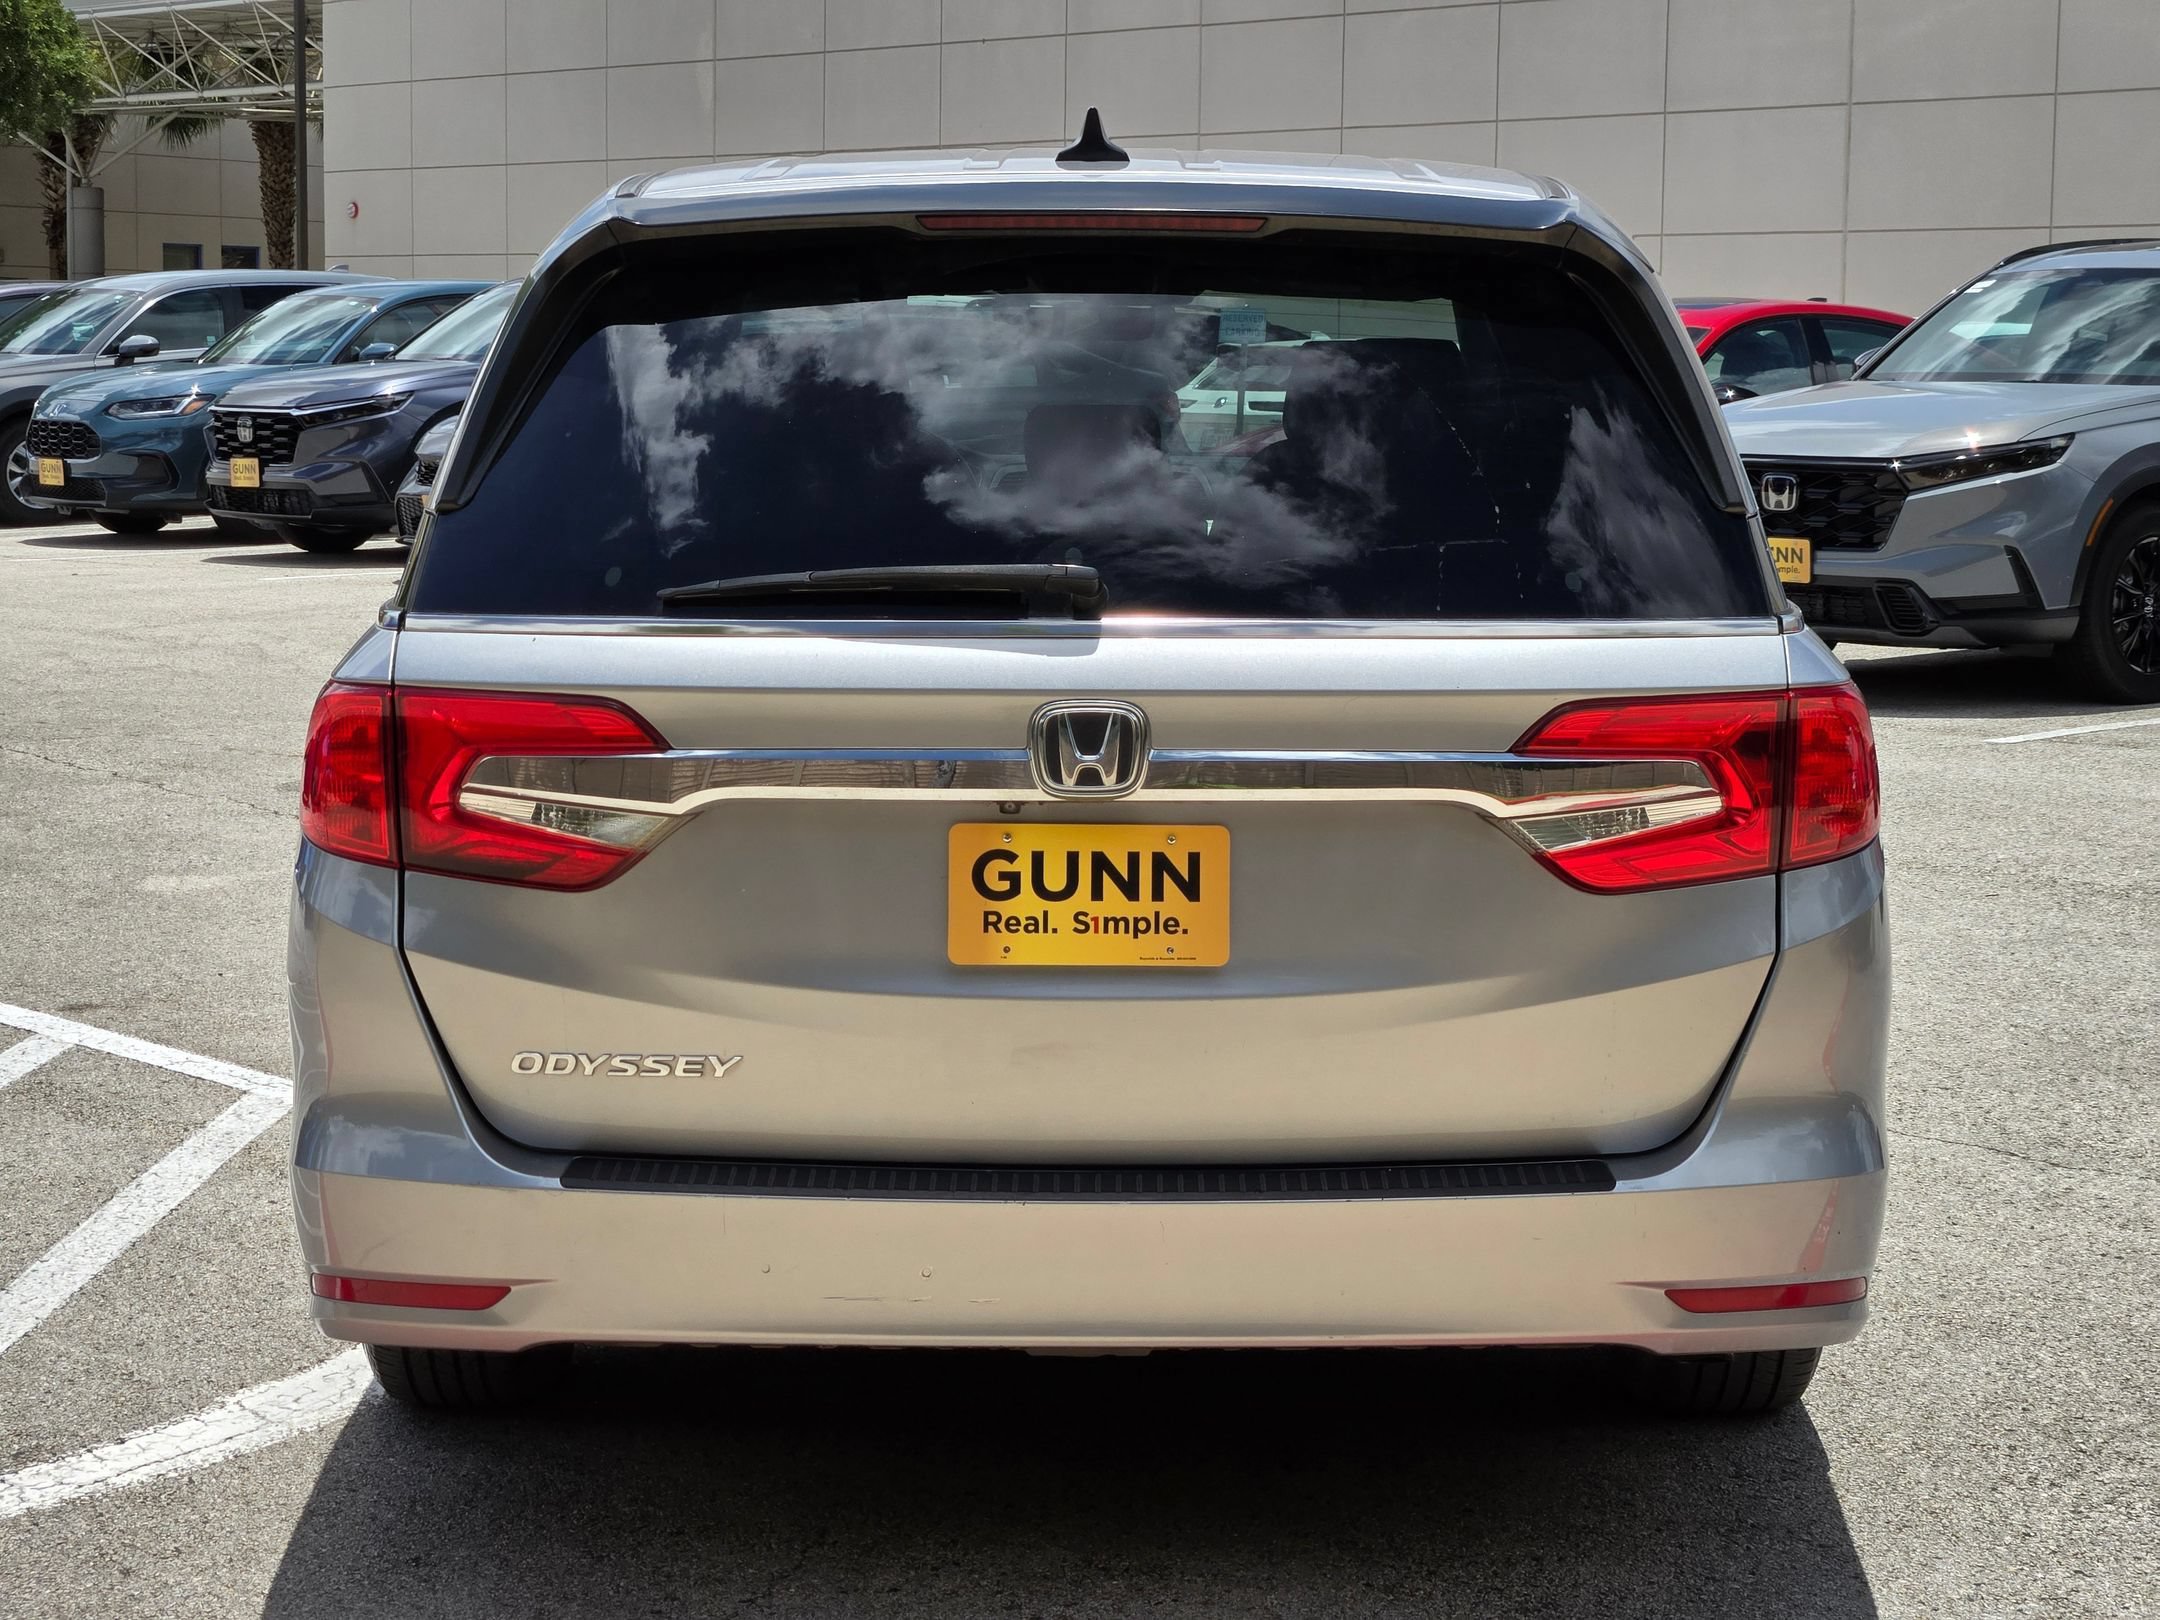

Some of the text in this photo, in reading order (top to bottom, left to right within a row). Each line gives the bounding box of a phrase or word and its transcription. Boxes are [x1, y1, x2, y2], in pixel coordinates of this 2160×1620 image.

[232, 463, 257, 475] GUNN
[1770, 546, 1804, 564] NN
[971, 848, 1201, 903] GUNN
[982, 910, 1059, 935] Real.
[510, 1051, 744, 1078] ODYSSEY
